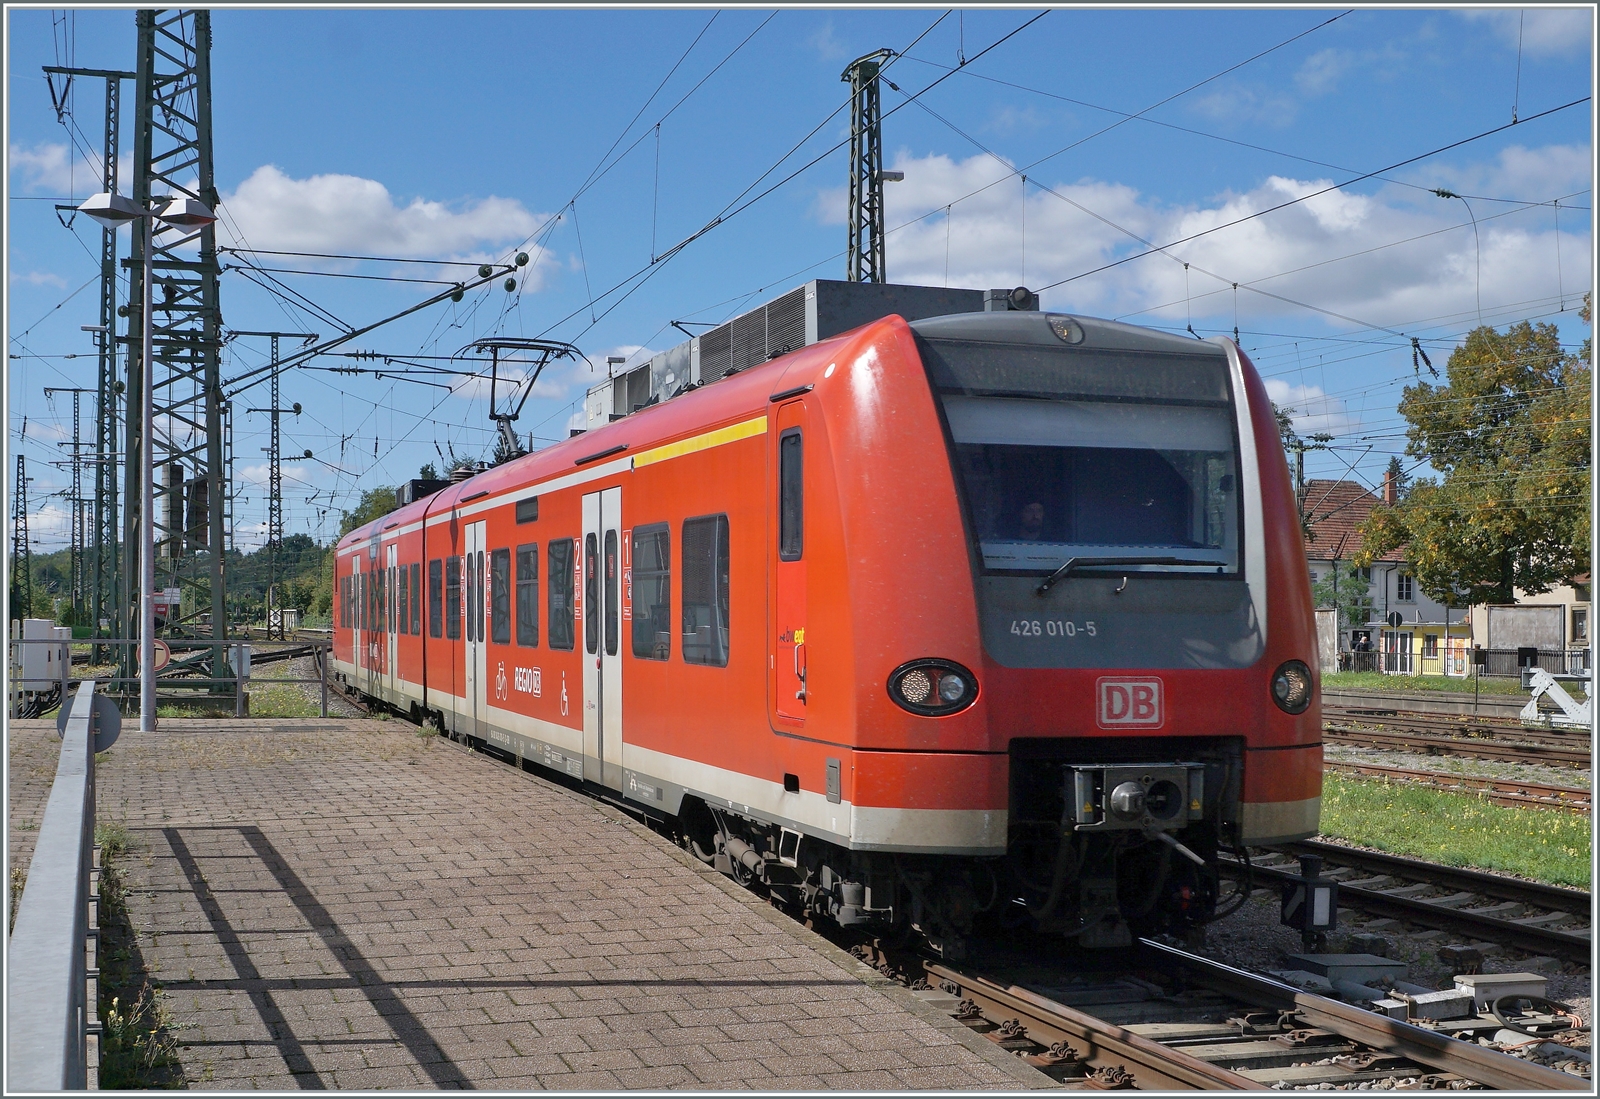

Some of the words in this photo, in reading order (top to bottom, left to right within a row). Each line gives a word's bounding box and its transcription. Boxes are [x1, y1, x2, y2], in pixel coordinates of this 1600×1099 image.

[575, 541, 581, 570] 2
[624, 534, 629, 565] 1
[1010, 620, 1042, 636] 426
[1046, 620, 1097, 637] 010-5
[514, 666, 533, 693] REGIO
[1104, 684, 1158, 721] DB
